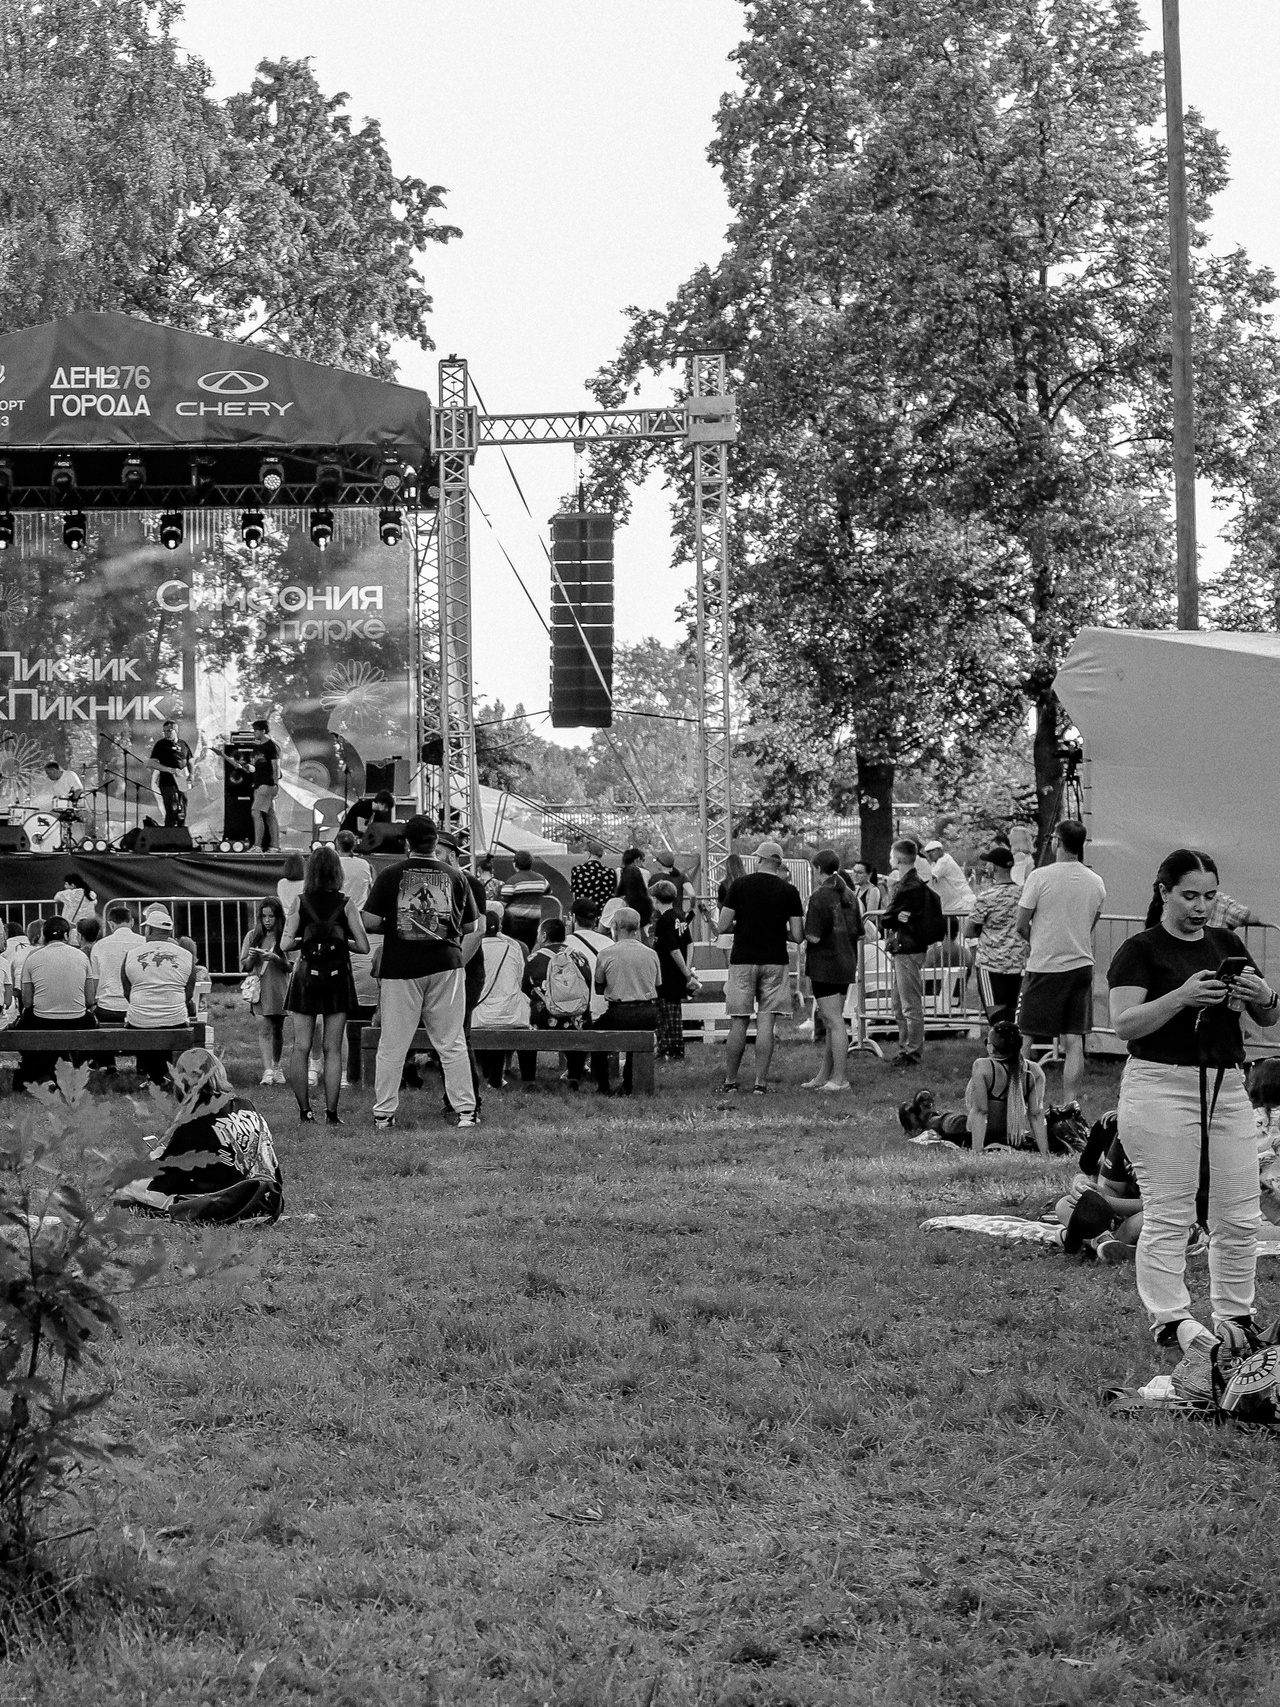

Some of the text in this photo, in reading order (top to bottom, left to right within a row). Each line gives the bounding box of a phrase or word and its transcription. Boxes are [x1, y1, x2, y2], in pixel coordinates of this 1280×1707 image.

[50, 366, 118, 389] ДЕНЬ
[50, 394, 151, 417] ГОРОДА
[175, 401, 294, 416] CHERY
[279, 619, 386, 645] парке
